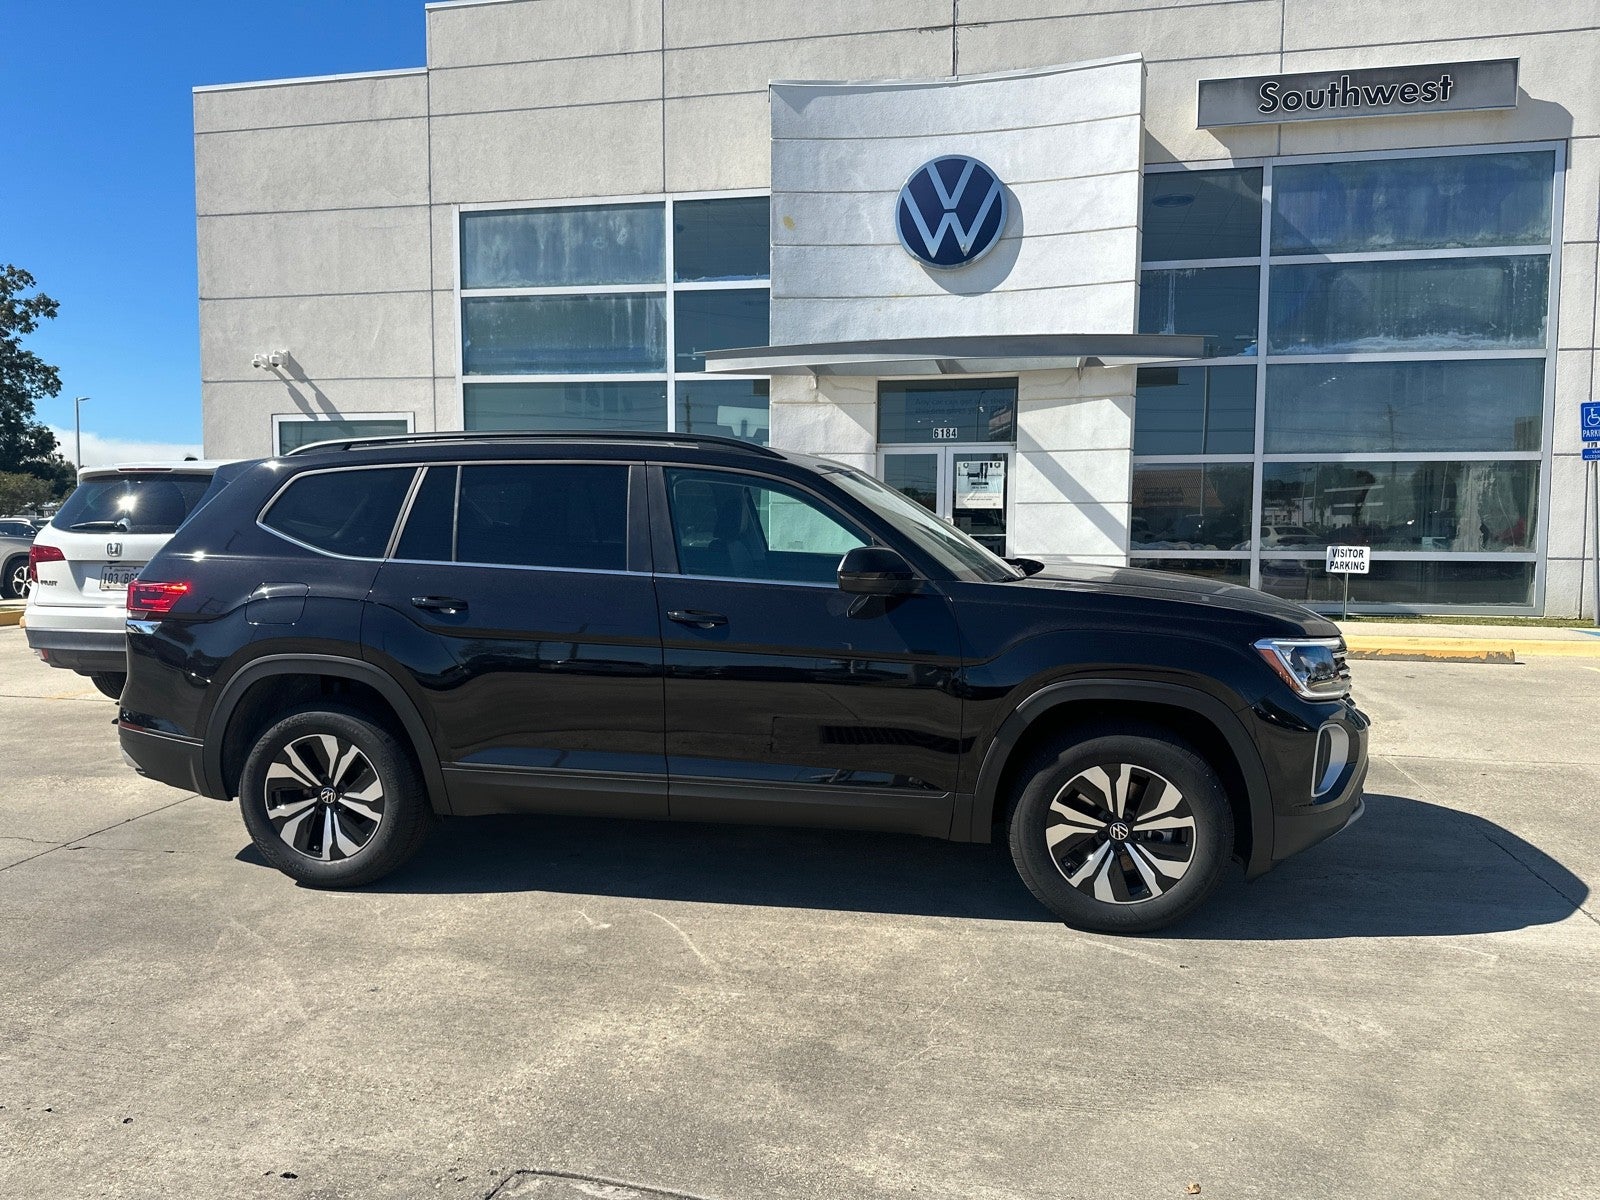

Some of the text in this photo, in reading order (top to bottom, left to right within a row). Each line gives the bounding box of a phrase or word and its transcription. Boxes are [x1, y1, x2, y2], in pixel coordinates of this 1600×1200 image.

[1257, 74, 1453, 114] Southwest
[933, 428, 957, 438] 6184
[1332, 548, 1364, 558] VISITOR
[1330, 561, 1365, 570] PARKING
[103, 572, 119, 584] 103
